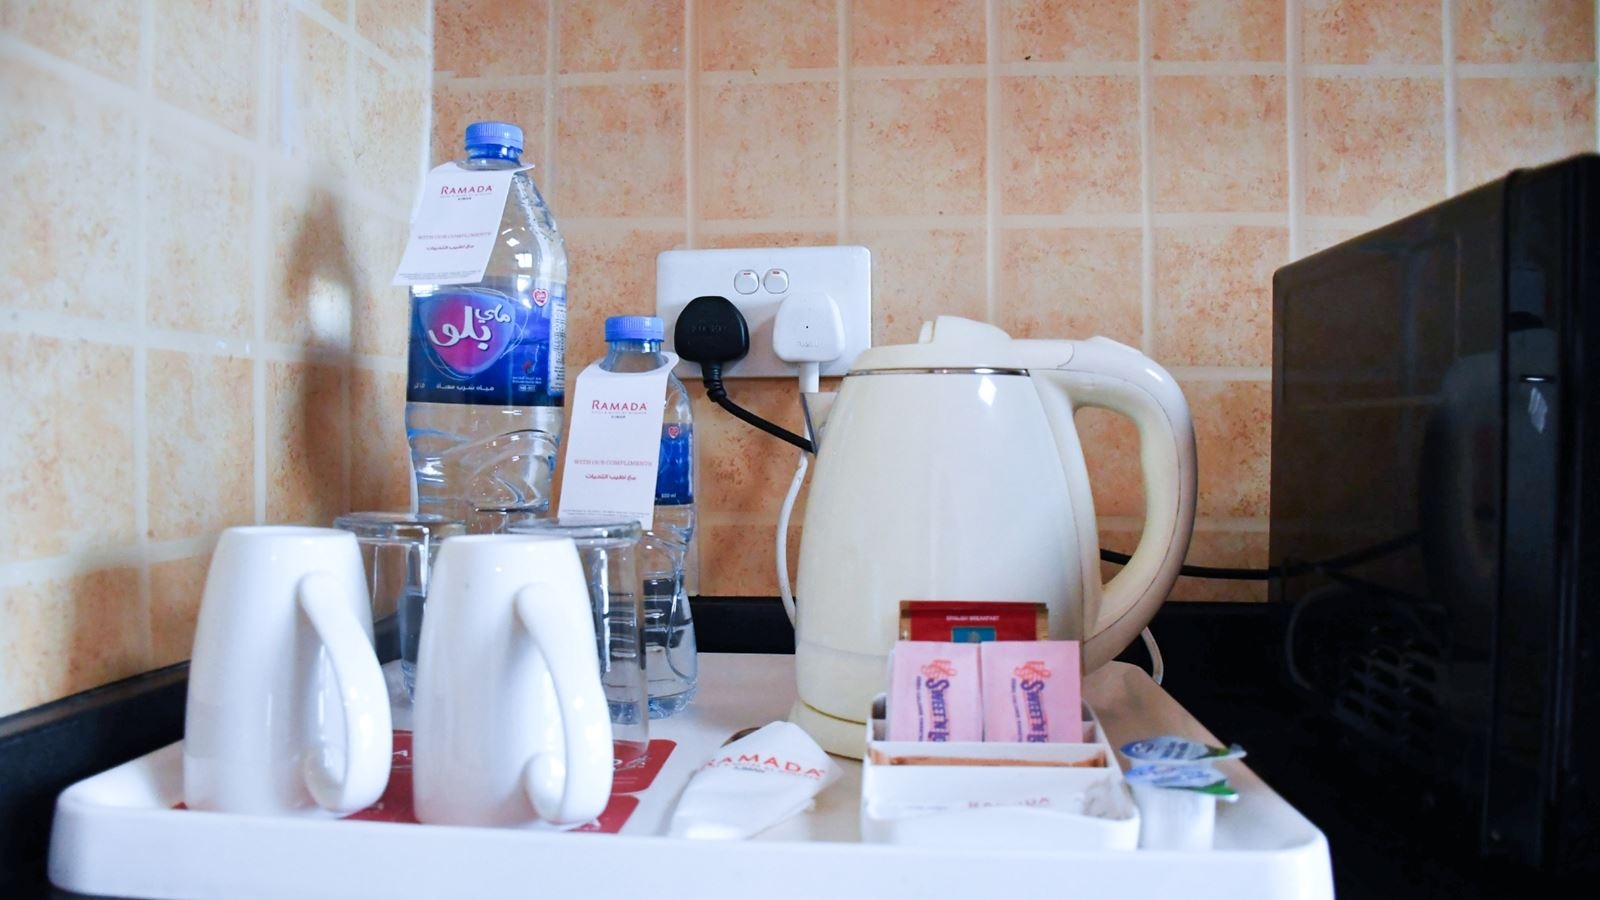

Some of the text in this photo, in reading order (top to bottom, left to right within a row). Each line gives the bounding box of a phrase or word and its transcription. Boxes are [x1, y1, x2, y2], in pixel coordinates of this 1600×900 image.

[440, 184, 494, 195] RAMADA
[474, 303, 511, 323] ماي
[428, 306, 492, 351] بلو
[591, 399, 648, 411] RAMADA
